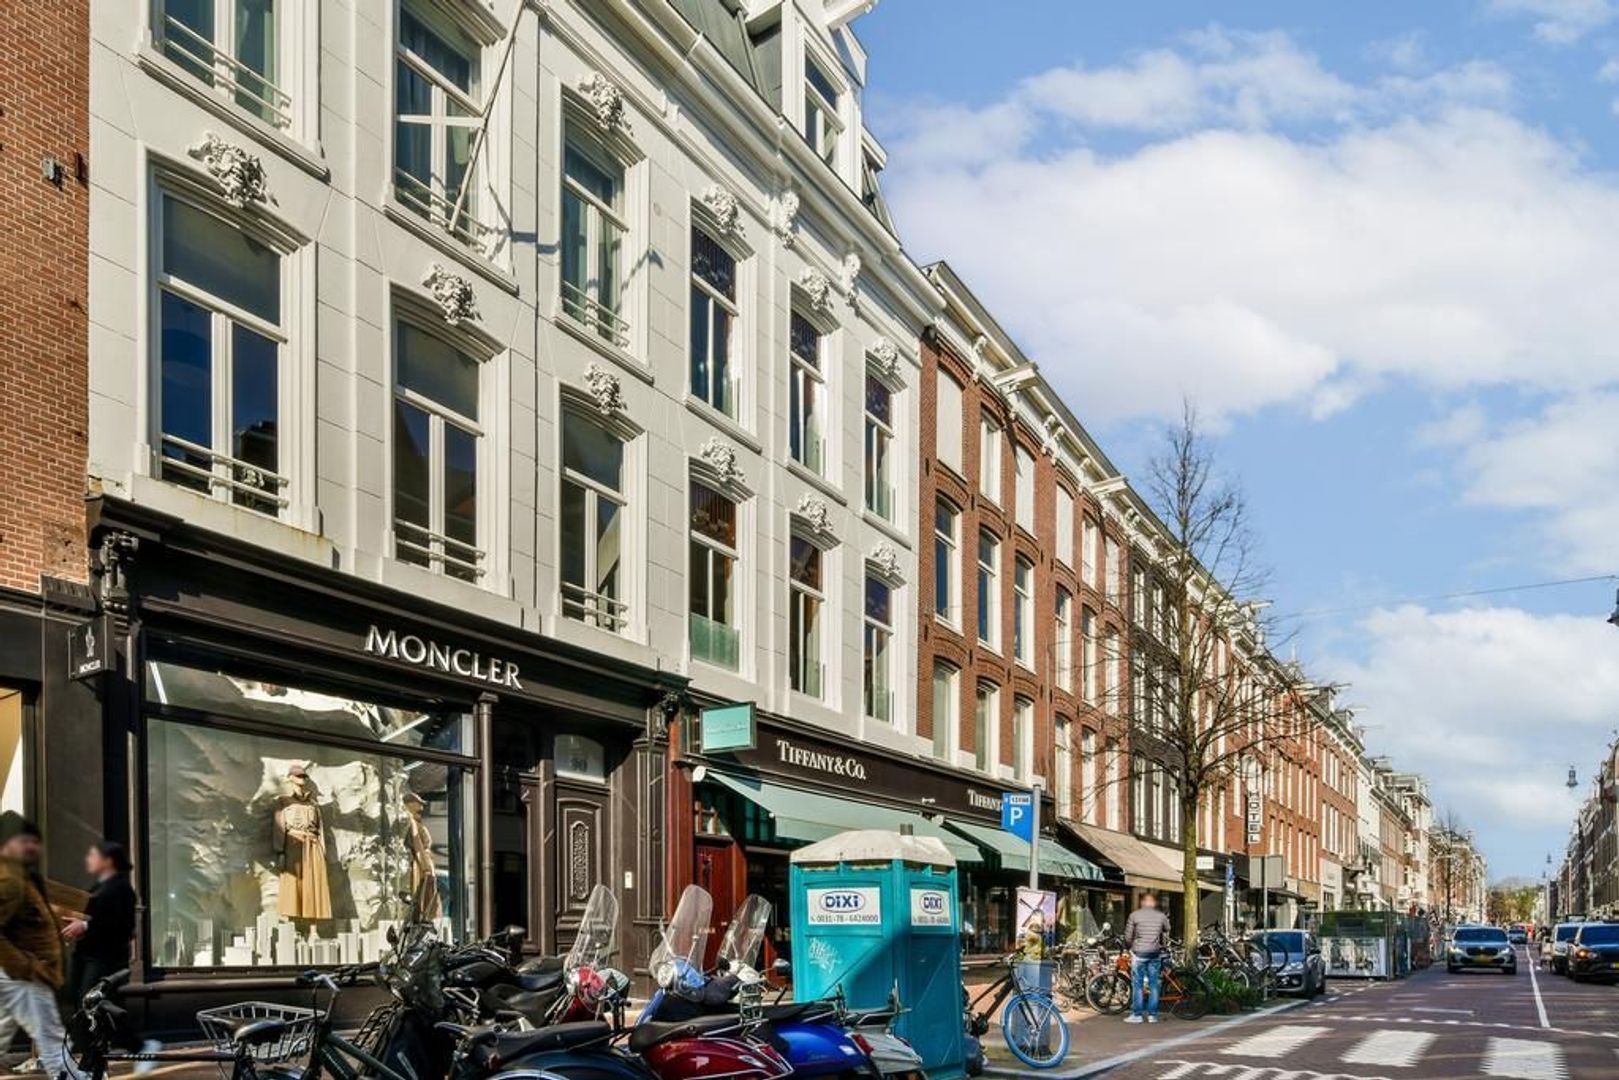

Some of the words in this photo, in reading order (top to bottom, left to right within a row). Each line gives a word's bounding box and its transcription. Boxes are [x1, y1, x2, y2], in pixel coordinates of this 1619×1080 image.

[364, 624, 522, 690] MONCLER
[1010, 807, 1023, 826] P
[1249, 791, 1260, 843] HOTEL
